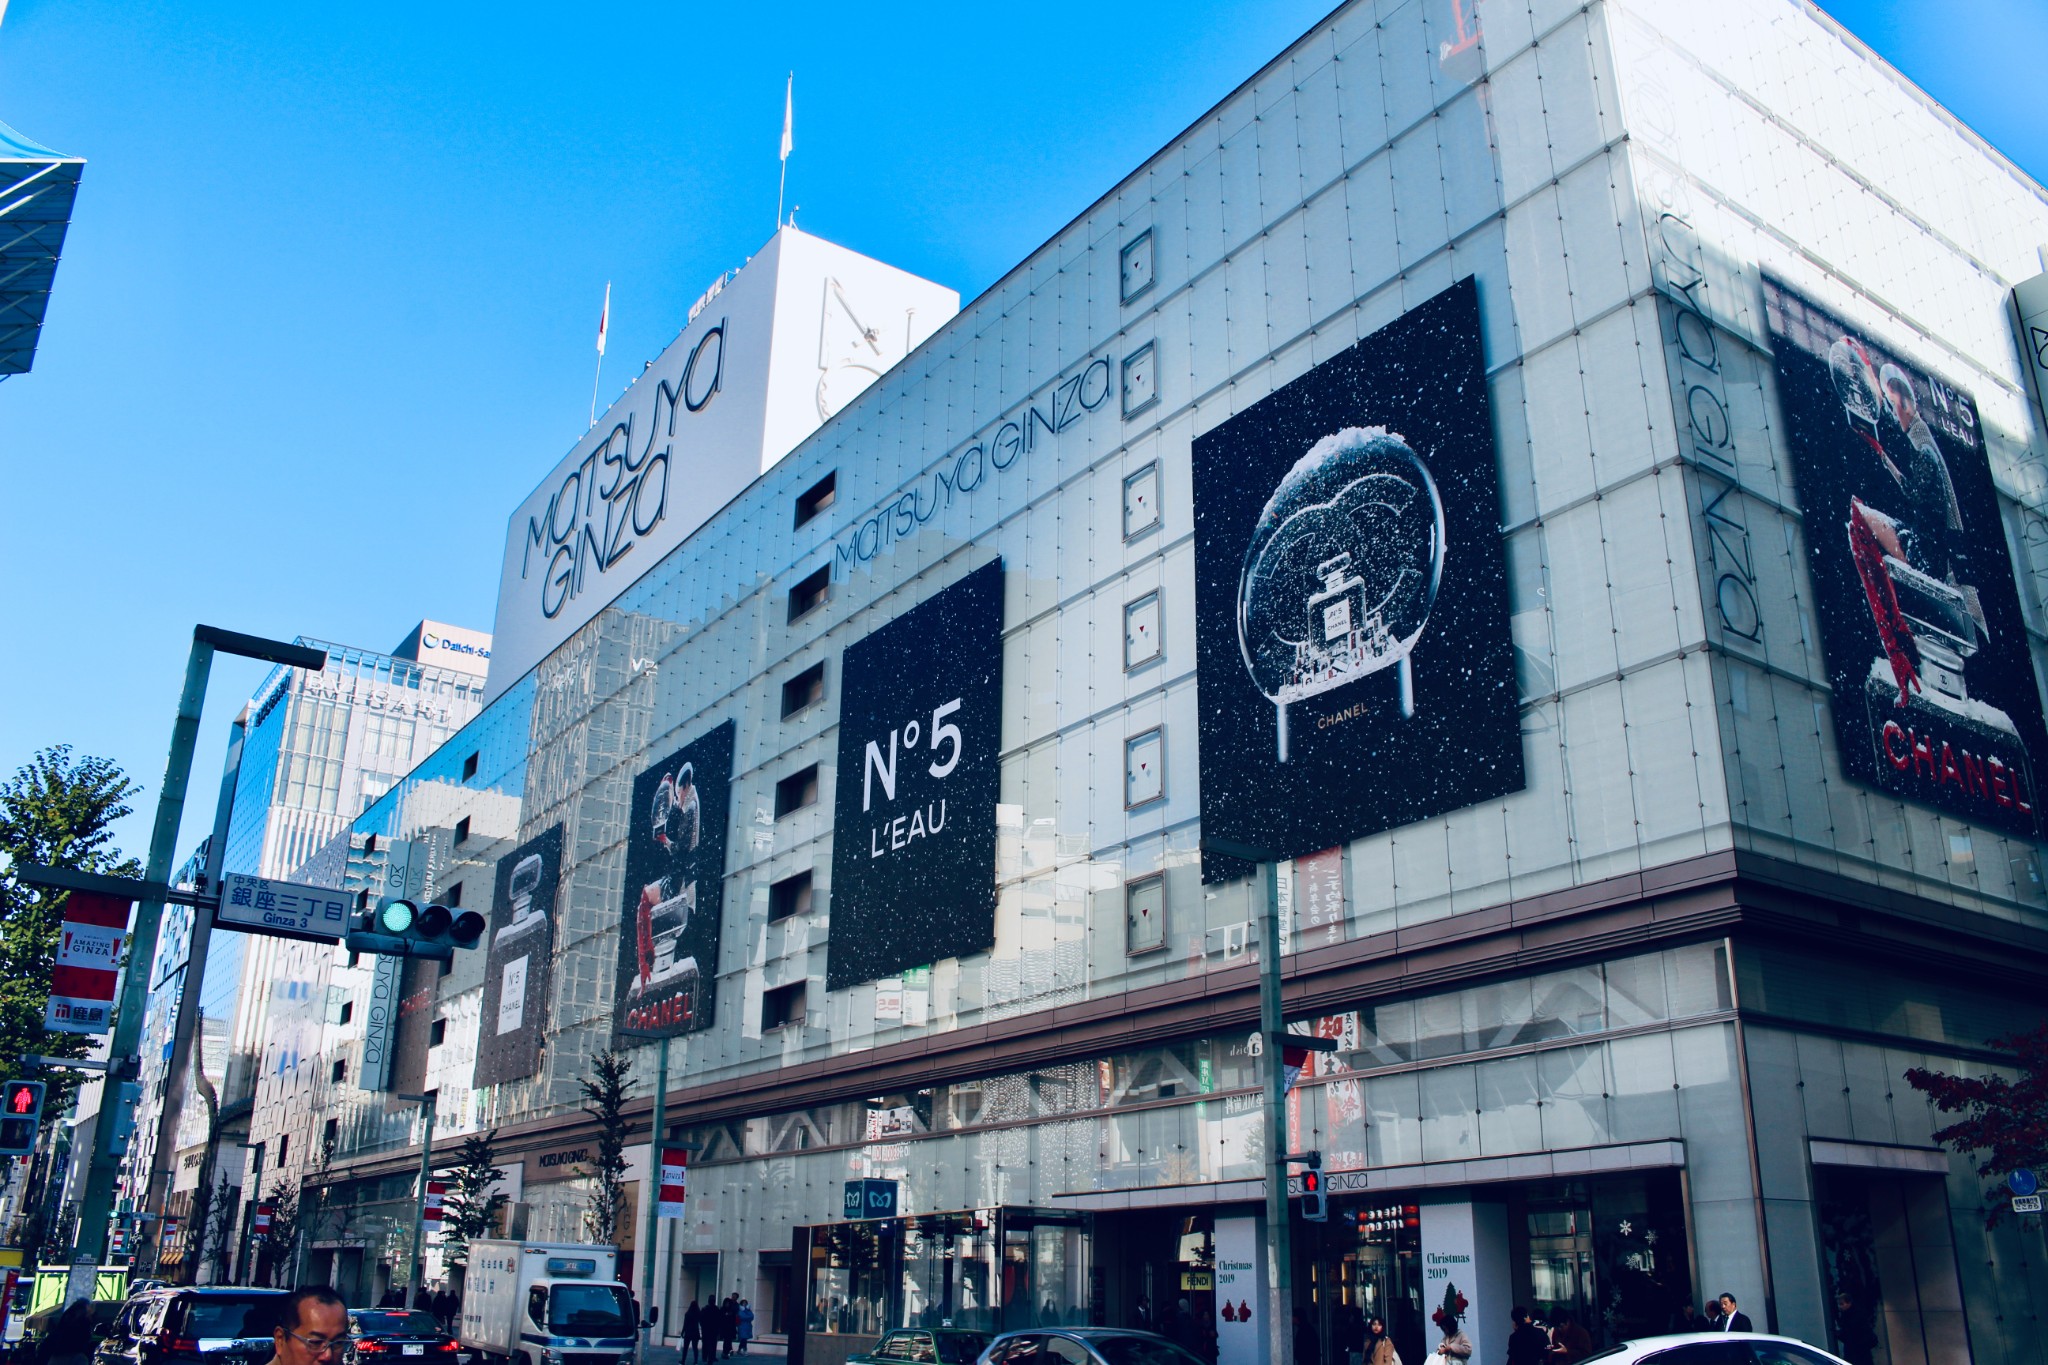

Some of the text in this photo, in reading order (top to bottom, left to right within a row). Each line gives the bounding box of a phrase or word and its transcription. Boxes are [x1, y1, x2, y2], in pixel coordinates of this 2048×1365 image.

[1941, 416, 1975, 447] L'EAU
[1318, 702, 1368, 729] CHANEL
[1883, 720, 2032, 814] CHANEL
[871, 799, 946, 858] L'EAU
[234, 876, 270, 890] 中央区
[231, 886, 344, 921] 銀座三丁目
[263, 912, 308, 928] Ginza 3
[501, 1000, 521, 1014] CHANEL
[627, 992, 693, 1029] CHANEL
[1219, 1260, 1253, 1271] Christmas
[1427, 1252, 1470, 1264] Christmas
[1219, 1274, 1235, 1284] 2019
[1428, 1268, 1448, 1279] 2019
